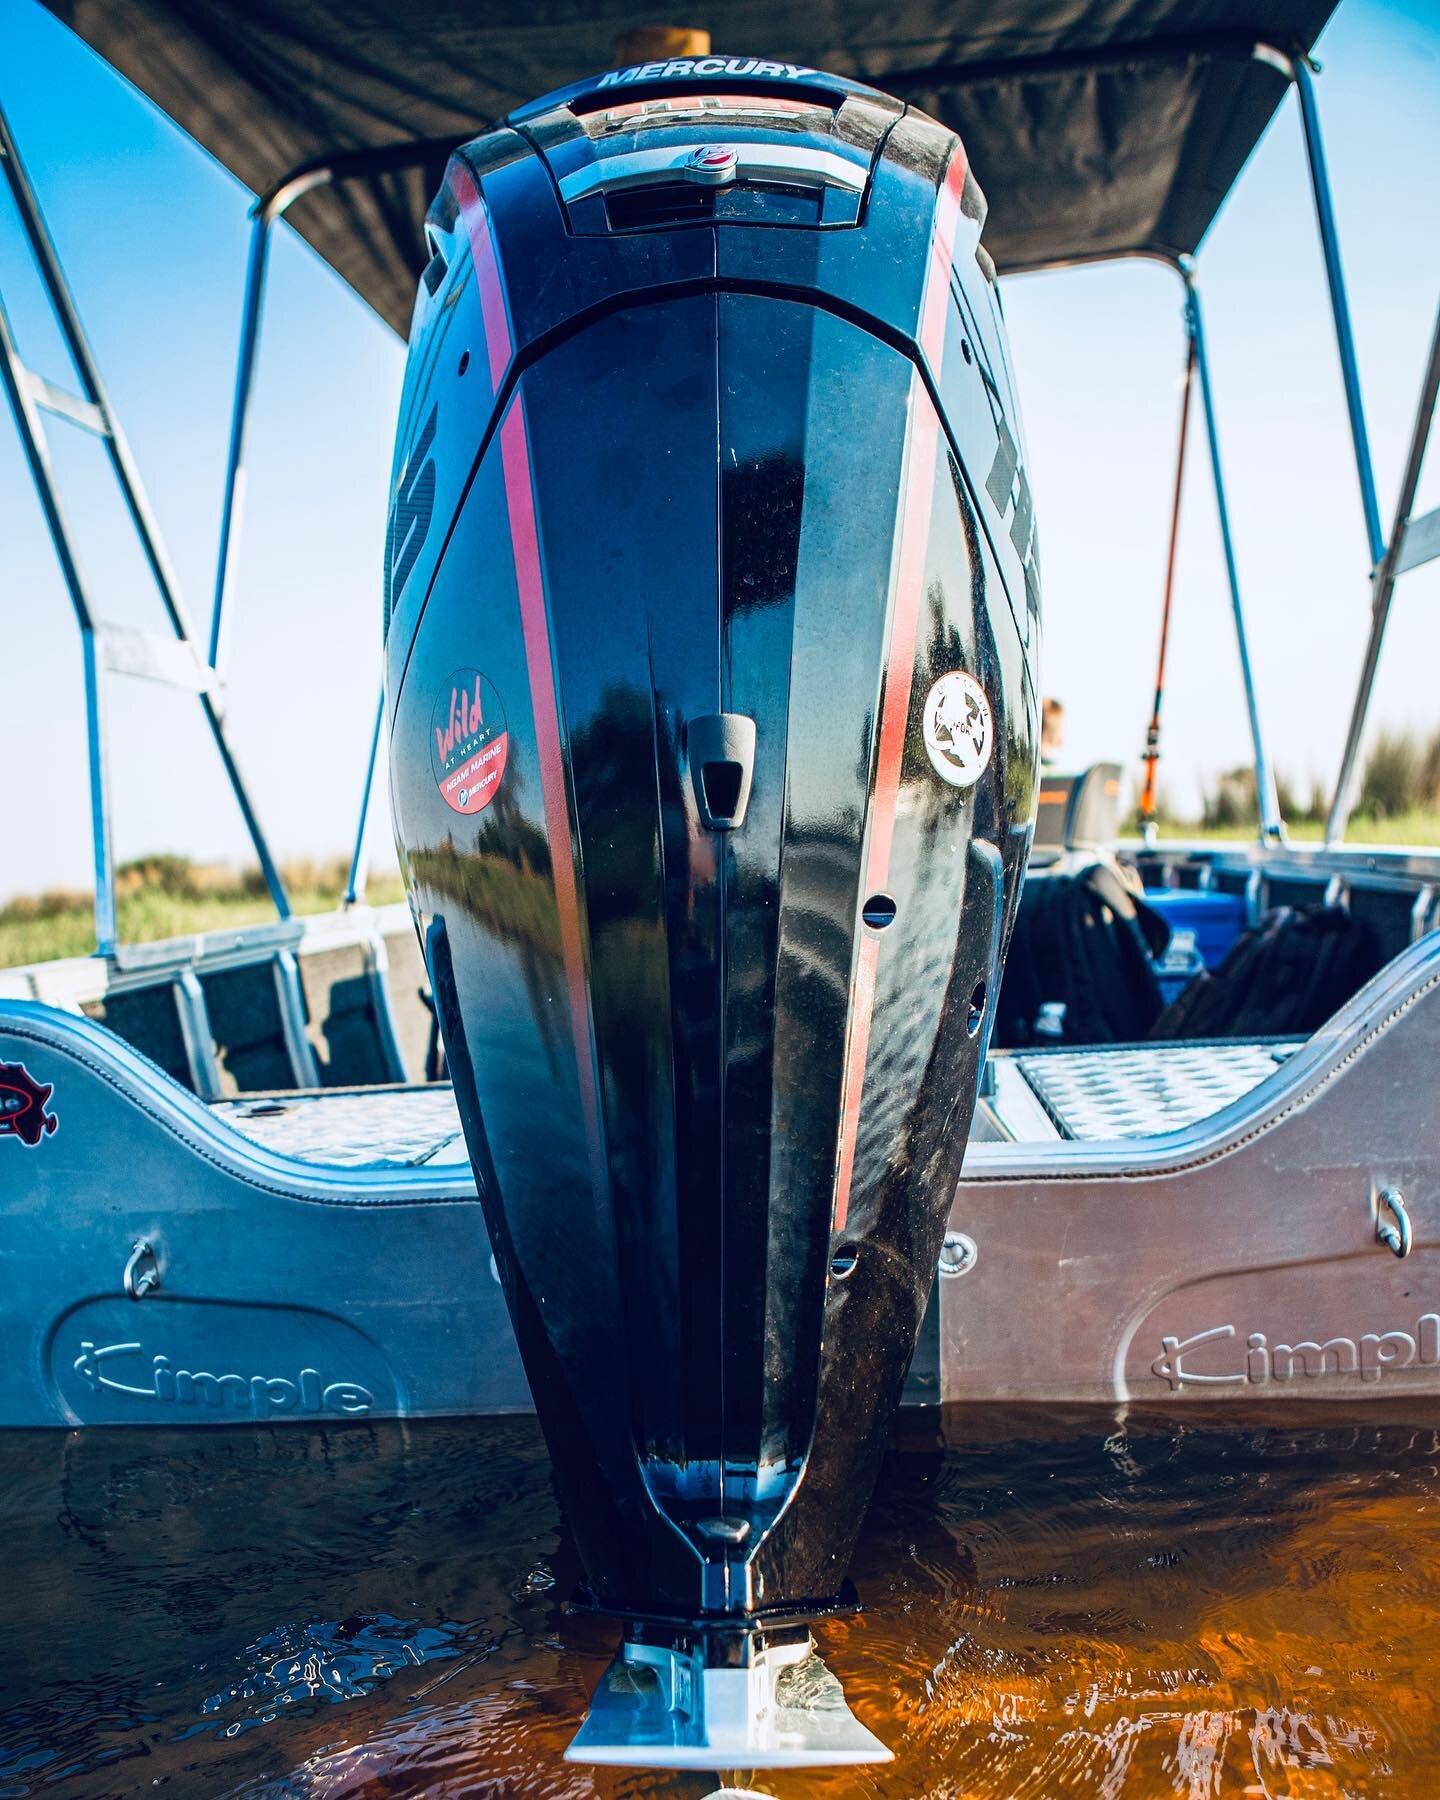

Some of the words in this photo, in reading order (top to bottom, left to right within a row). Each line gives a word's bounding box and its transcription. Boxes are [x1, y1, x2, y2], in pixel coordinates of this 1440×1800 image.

[597, 59, 816, 88] MERCURY
[435, 675, 483, 764] Wild
[445, 757, 455, 770] AT
[461, 728, 491, 757] HEART
[446, 768, 470, 793] NGAMI
[470, 743, 502, 774] MARINE
[469, 769, 498, 798] MERCURY
[73, 1341, 374, 1418] Kimple
